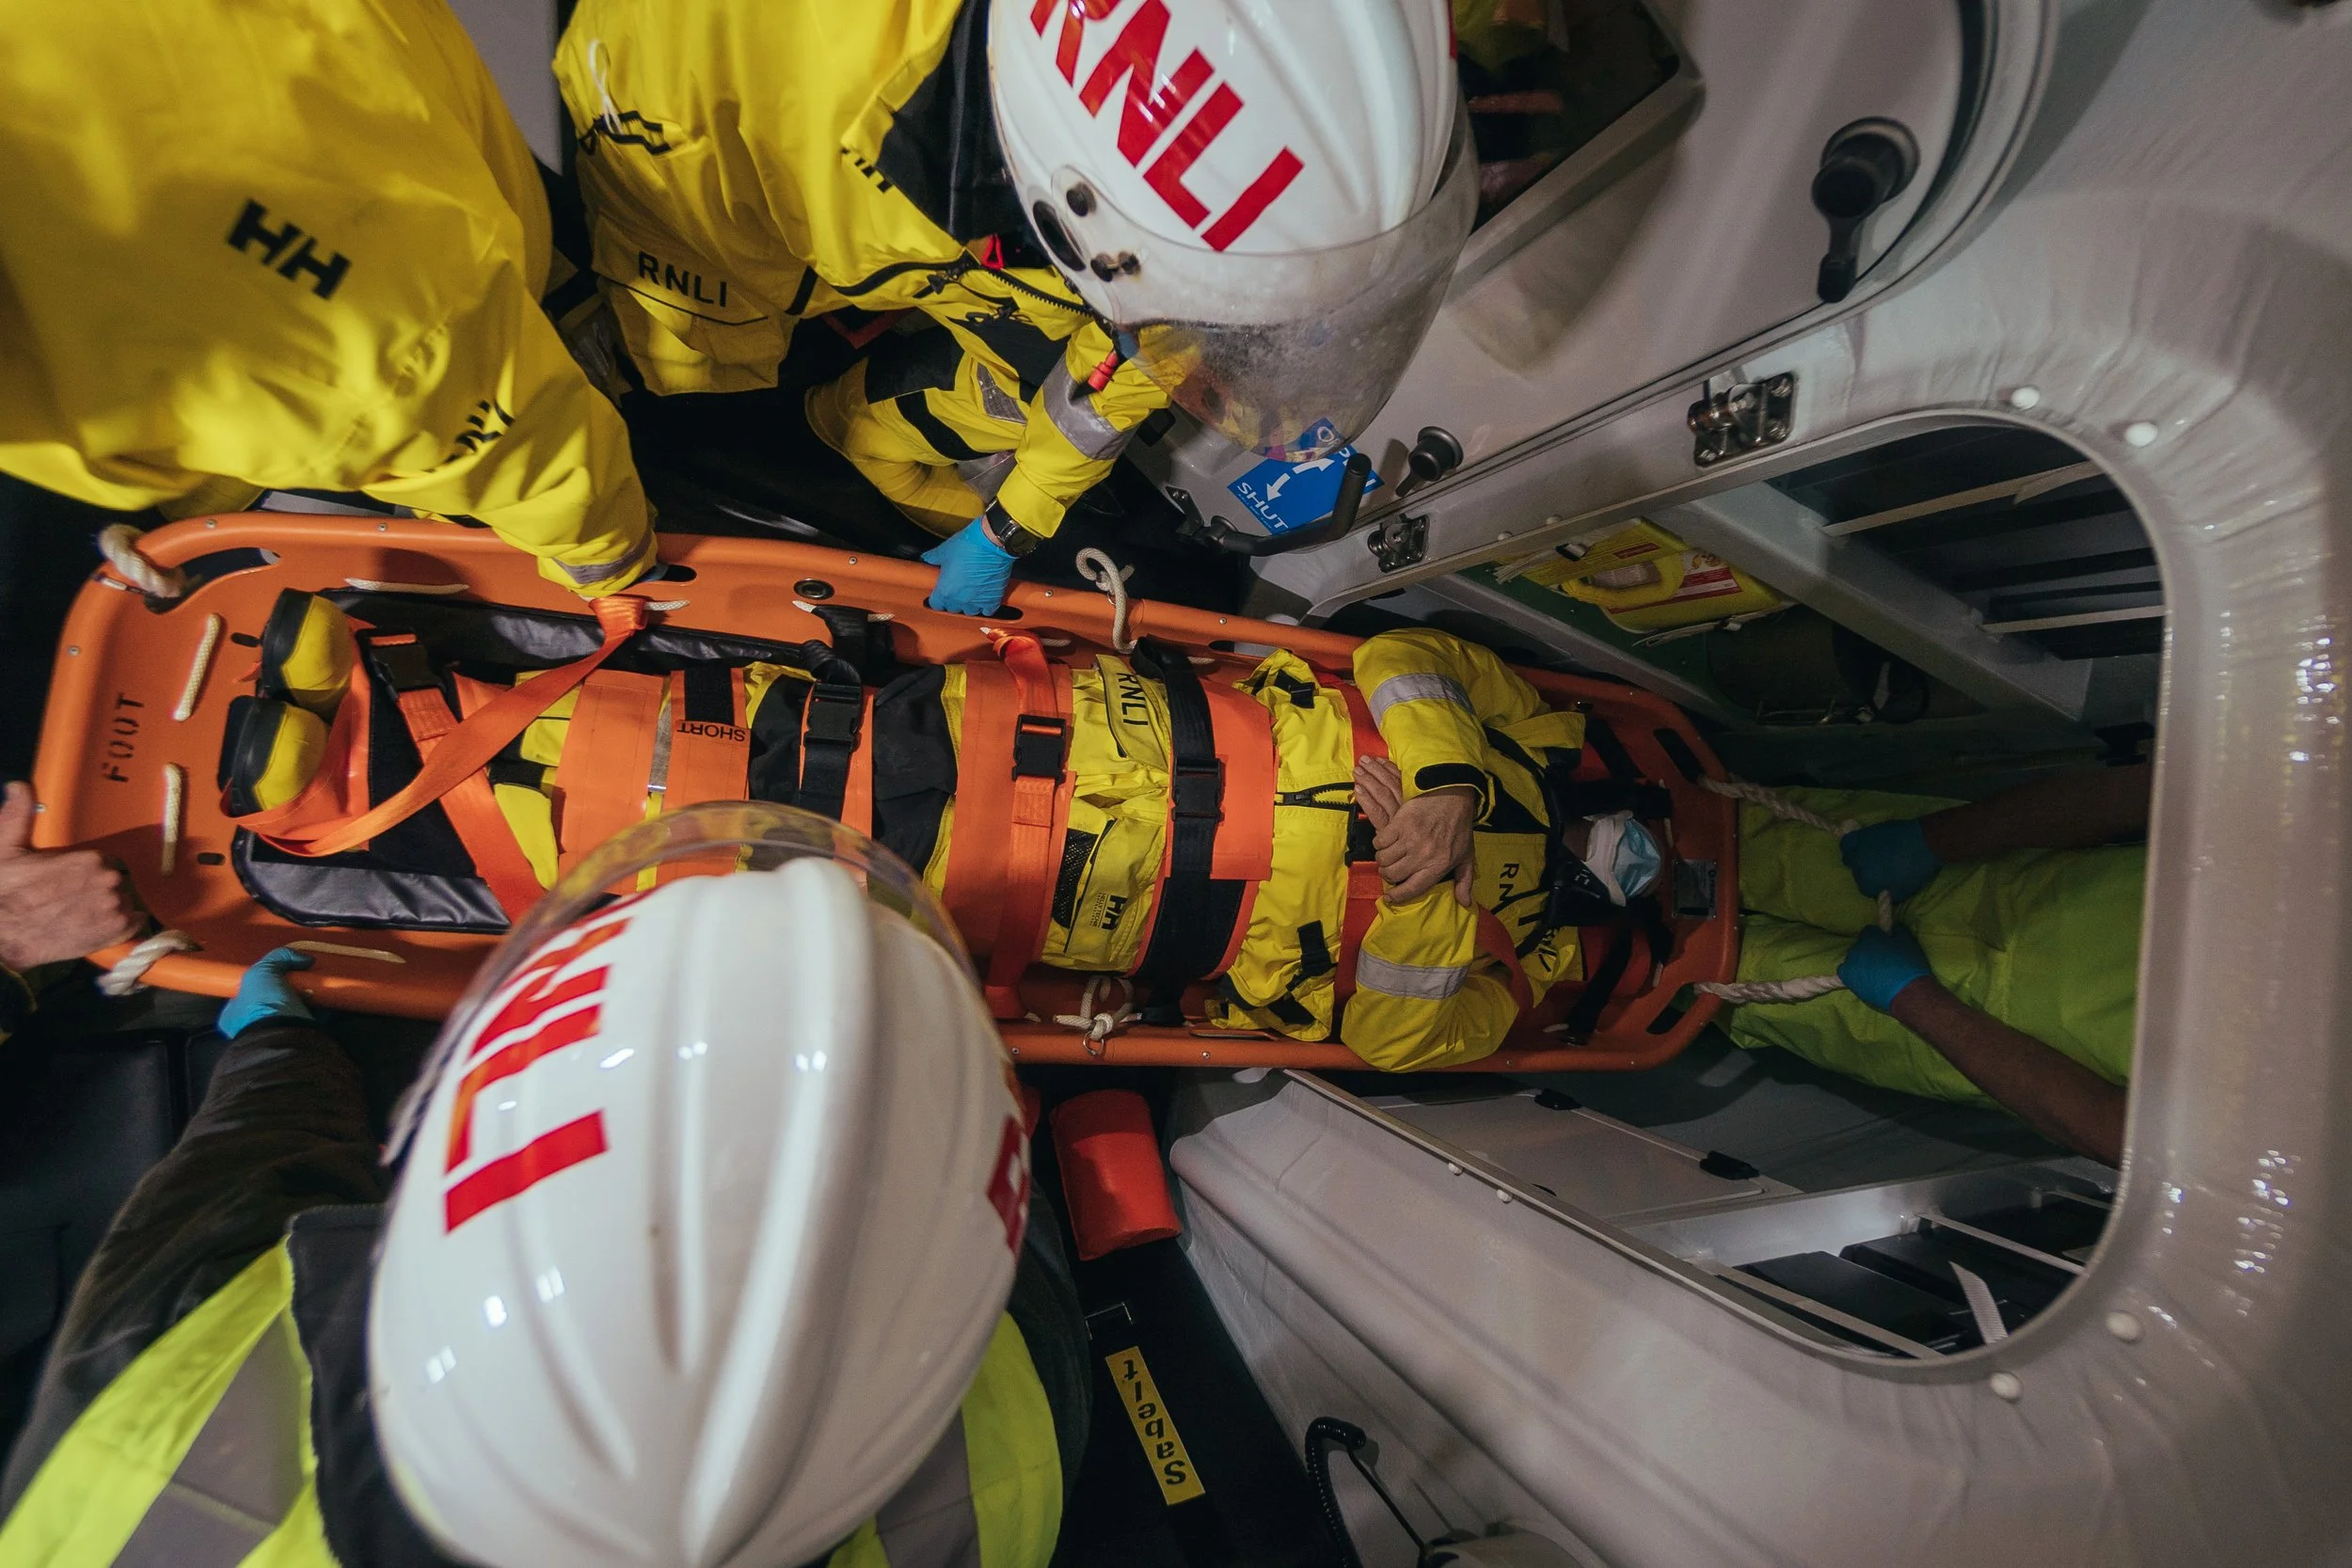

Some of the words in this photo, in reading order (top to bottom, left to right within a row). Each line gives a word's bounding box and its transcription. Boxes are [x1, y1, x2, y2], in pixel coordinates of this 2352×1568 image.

[228, 198, 353, 300] HH
[638, 249, 729, 309] RNLI
[1237, 482, 1288, 529] SHUT
[1116, 672, 1150, 727] RNLI
[101, 691, 146, 784] FOOT
[675, 721, 746, 742] SHORT
[1121, 1358, 1187, 1487] Sabelt
